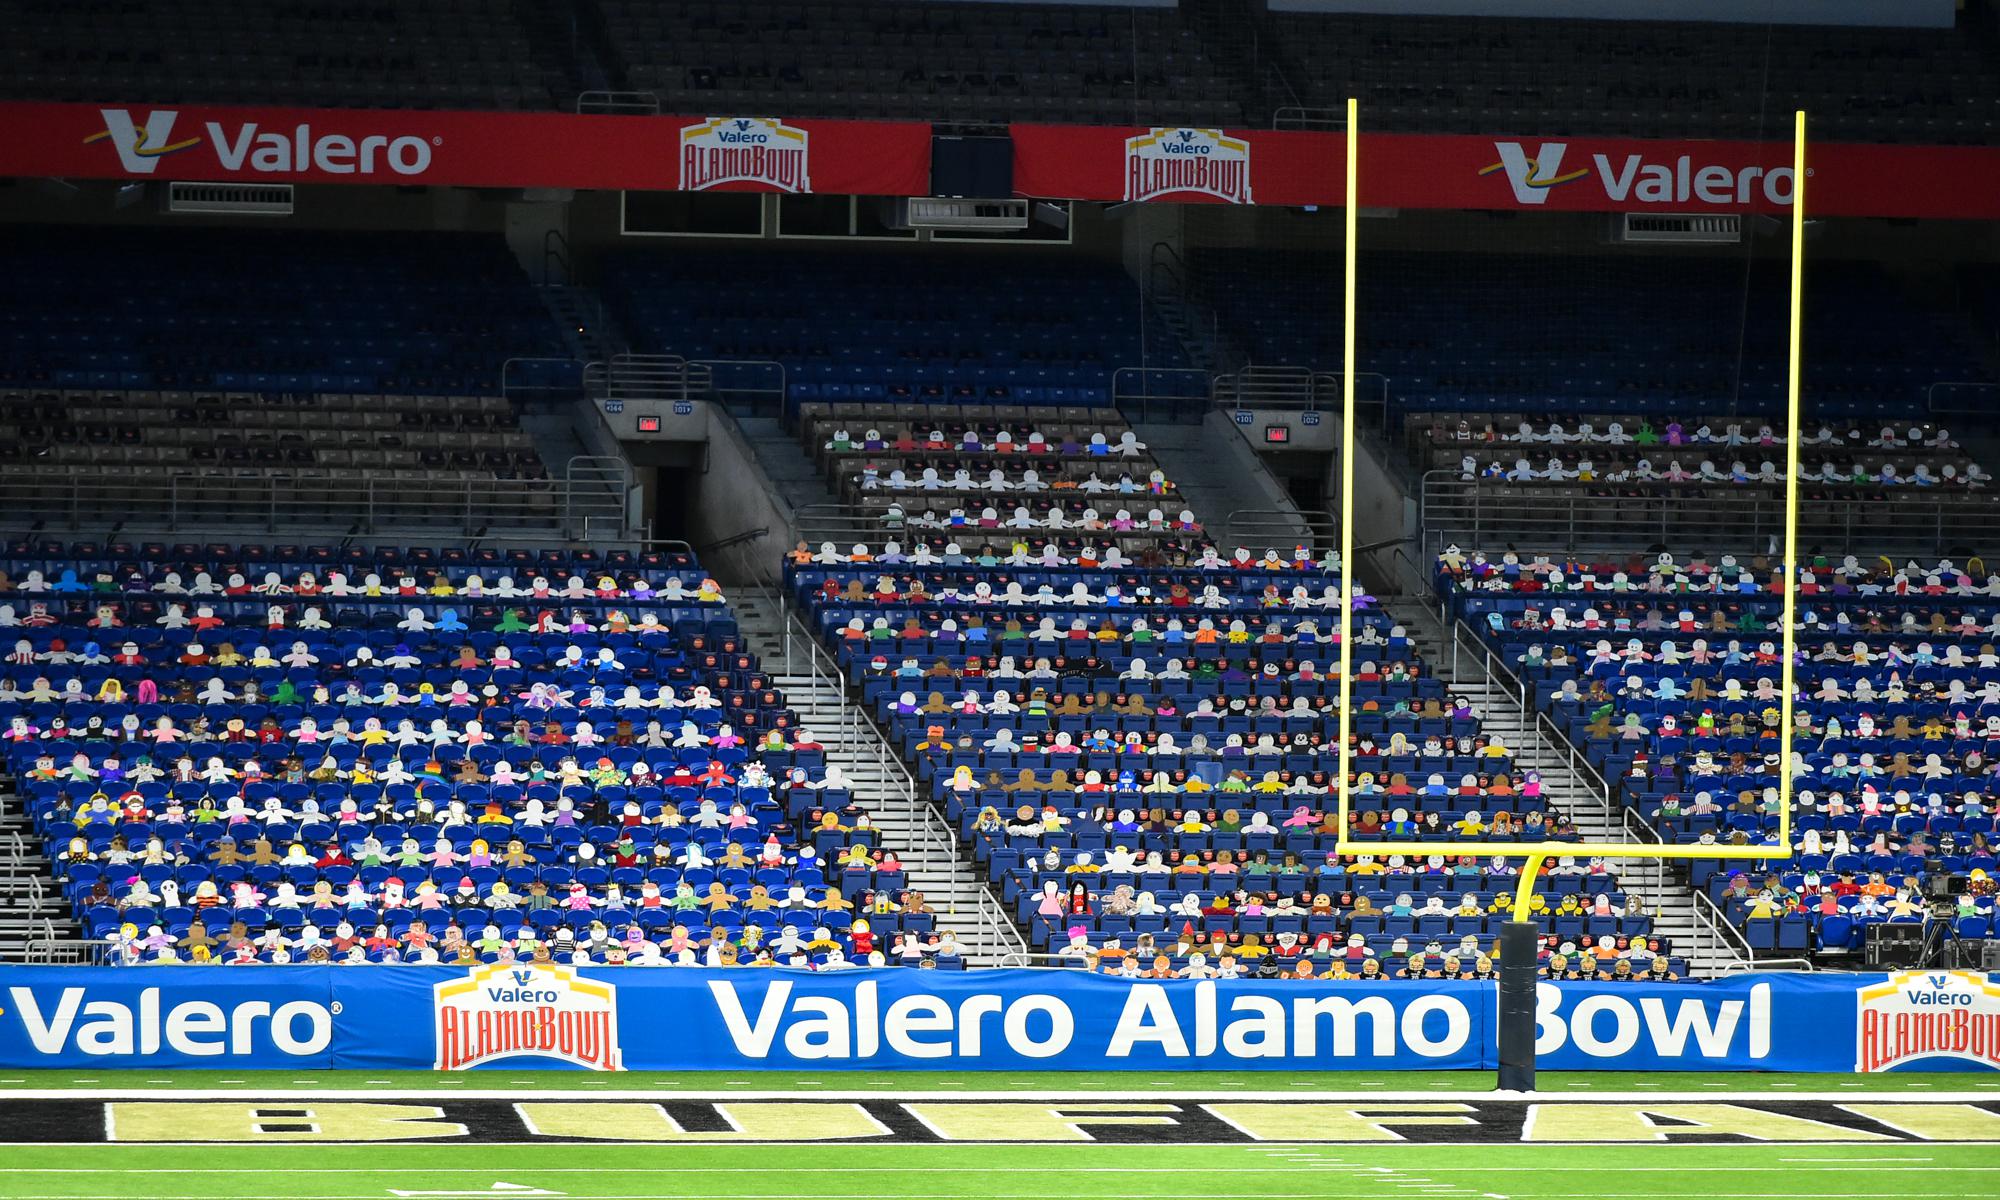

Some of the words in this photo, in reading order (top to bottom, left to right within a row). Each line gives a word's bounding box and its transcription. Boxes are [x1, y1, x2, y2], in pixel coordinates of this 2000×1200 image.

[718, 131, 768, 143] Valero
[206, 121, 432, 175] Valero
[1162, 142, 1210, 154] Valero
[1593, 154, 1797, 205] Valero
[1241, 415, 1252, 423] 101
[488, 987, 558, 1003] Valero
[1907, 990, 1972, 1006] Valero
[708, 980, 1075, 1059] Valero
[1105, 980, 1470, 1059] Alamo
